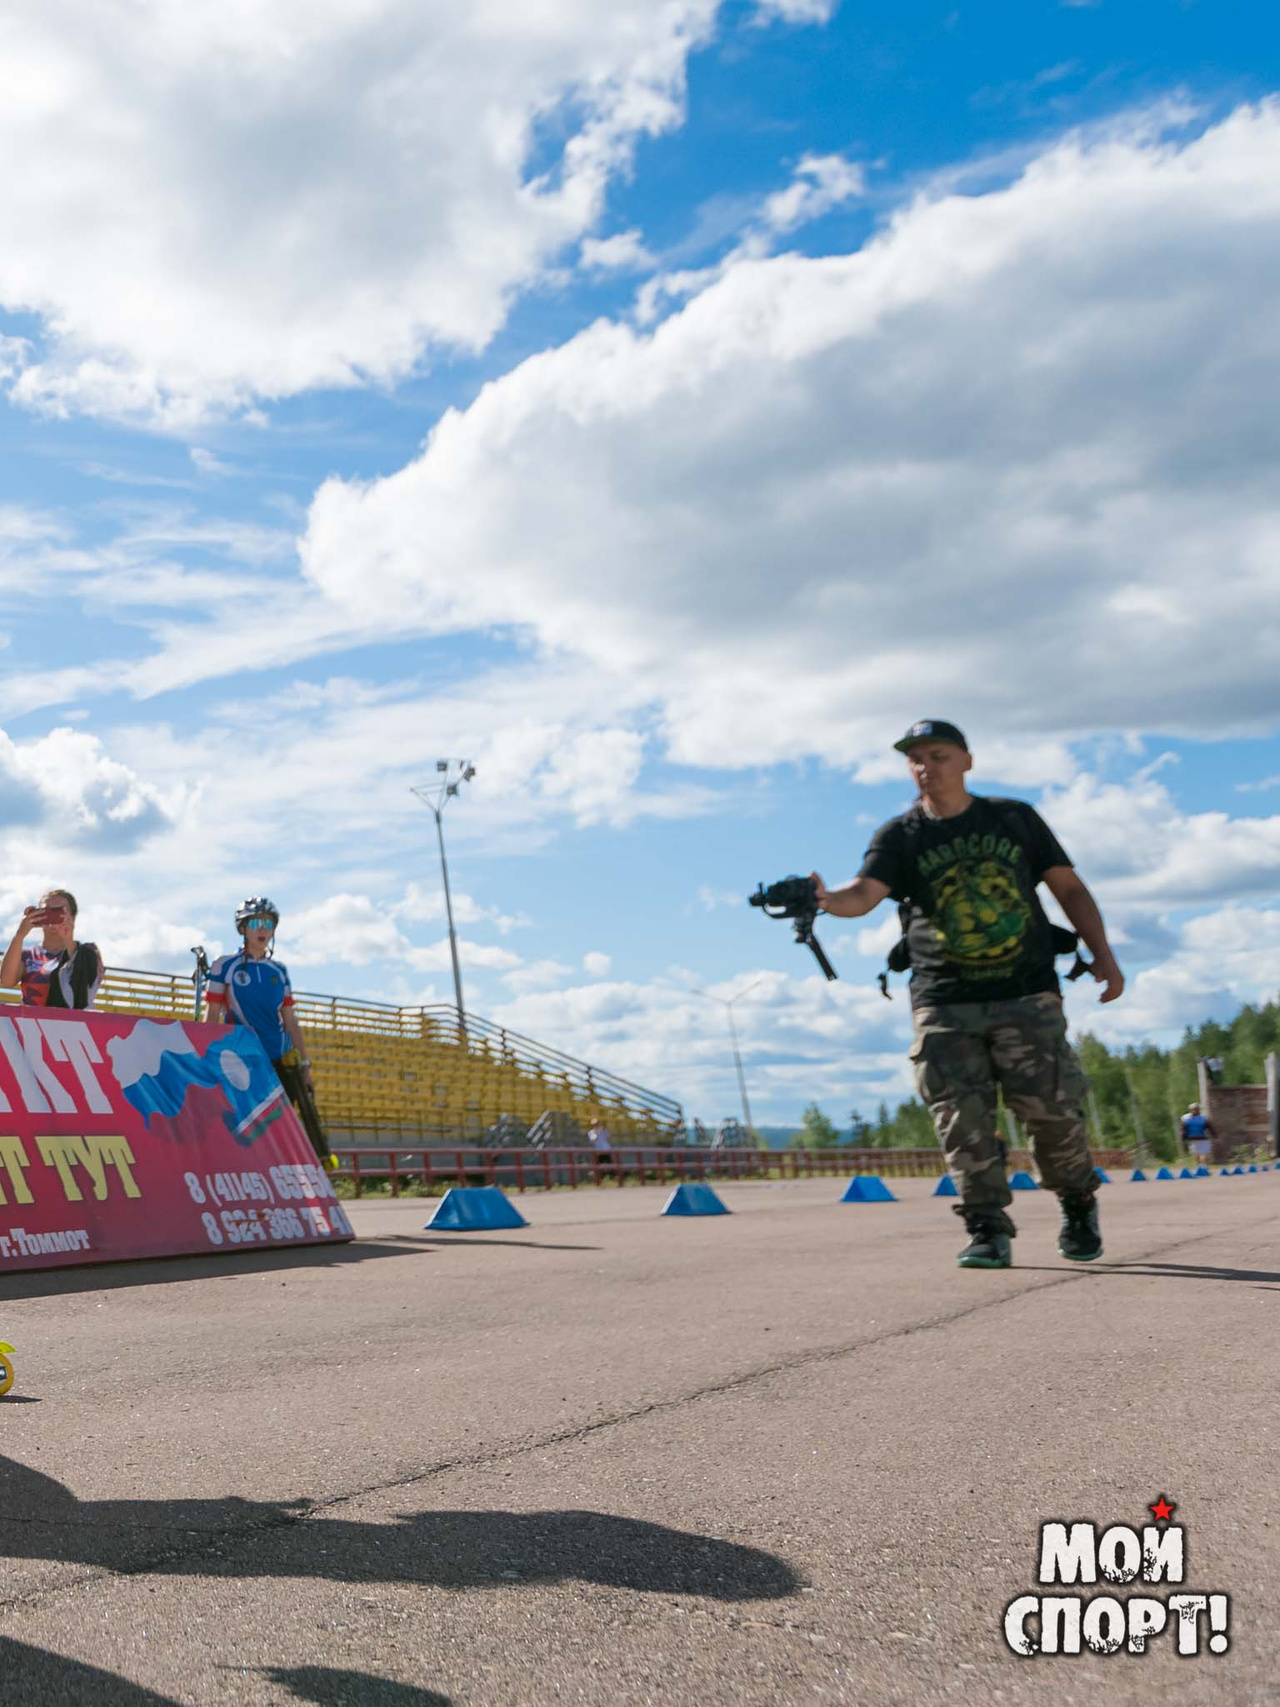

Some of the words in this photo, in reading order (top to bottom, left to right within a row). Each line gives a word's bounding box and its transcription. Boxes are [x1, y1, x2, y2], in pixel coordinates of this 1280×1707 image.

[35, 1136, 142, 1203] ТУТ
[184, 1172, 206, 1203] 8
[202, 1212, 223, 1245] 8
